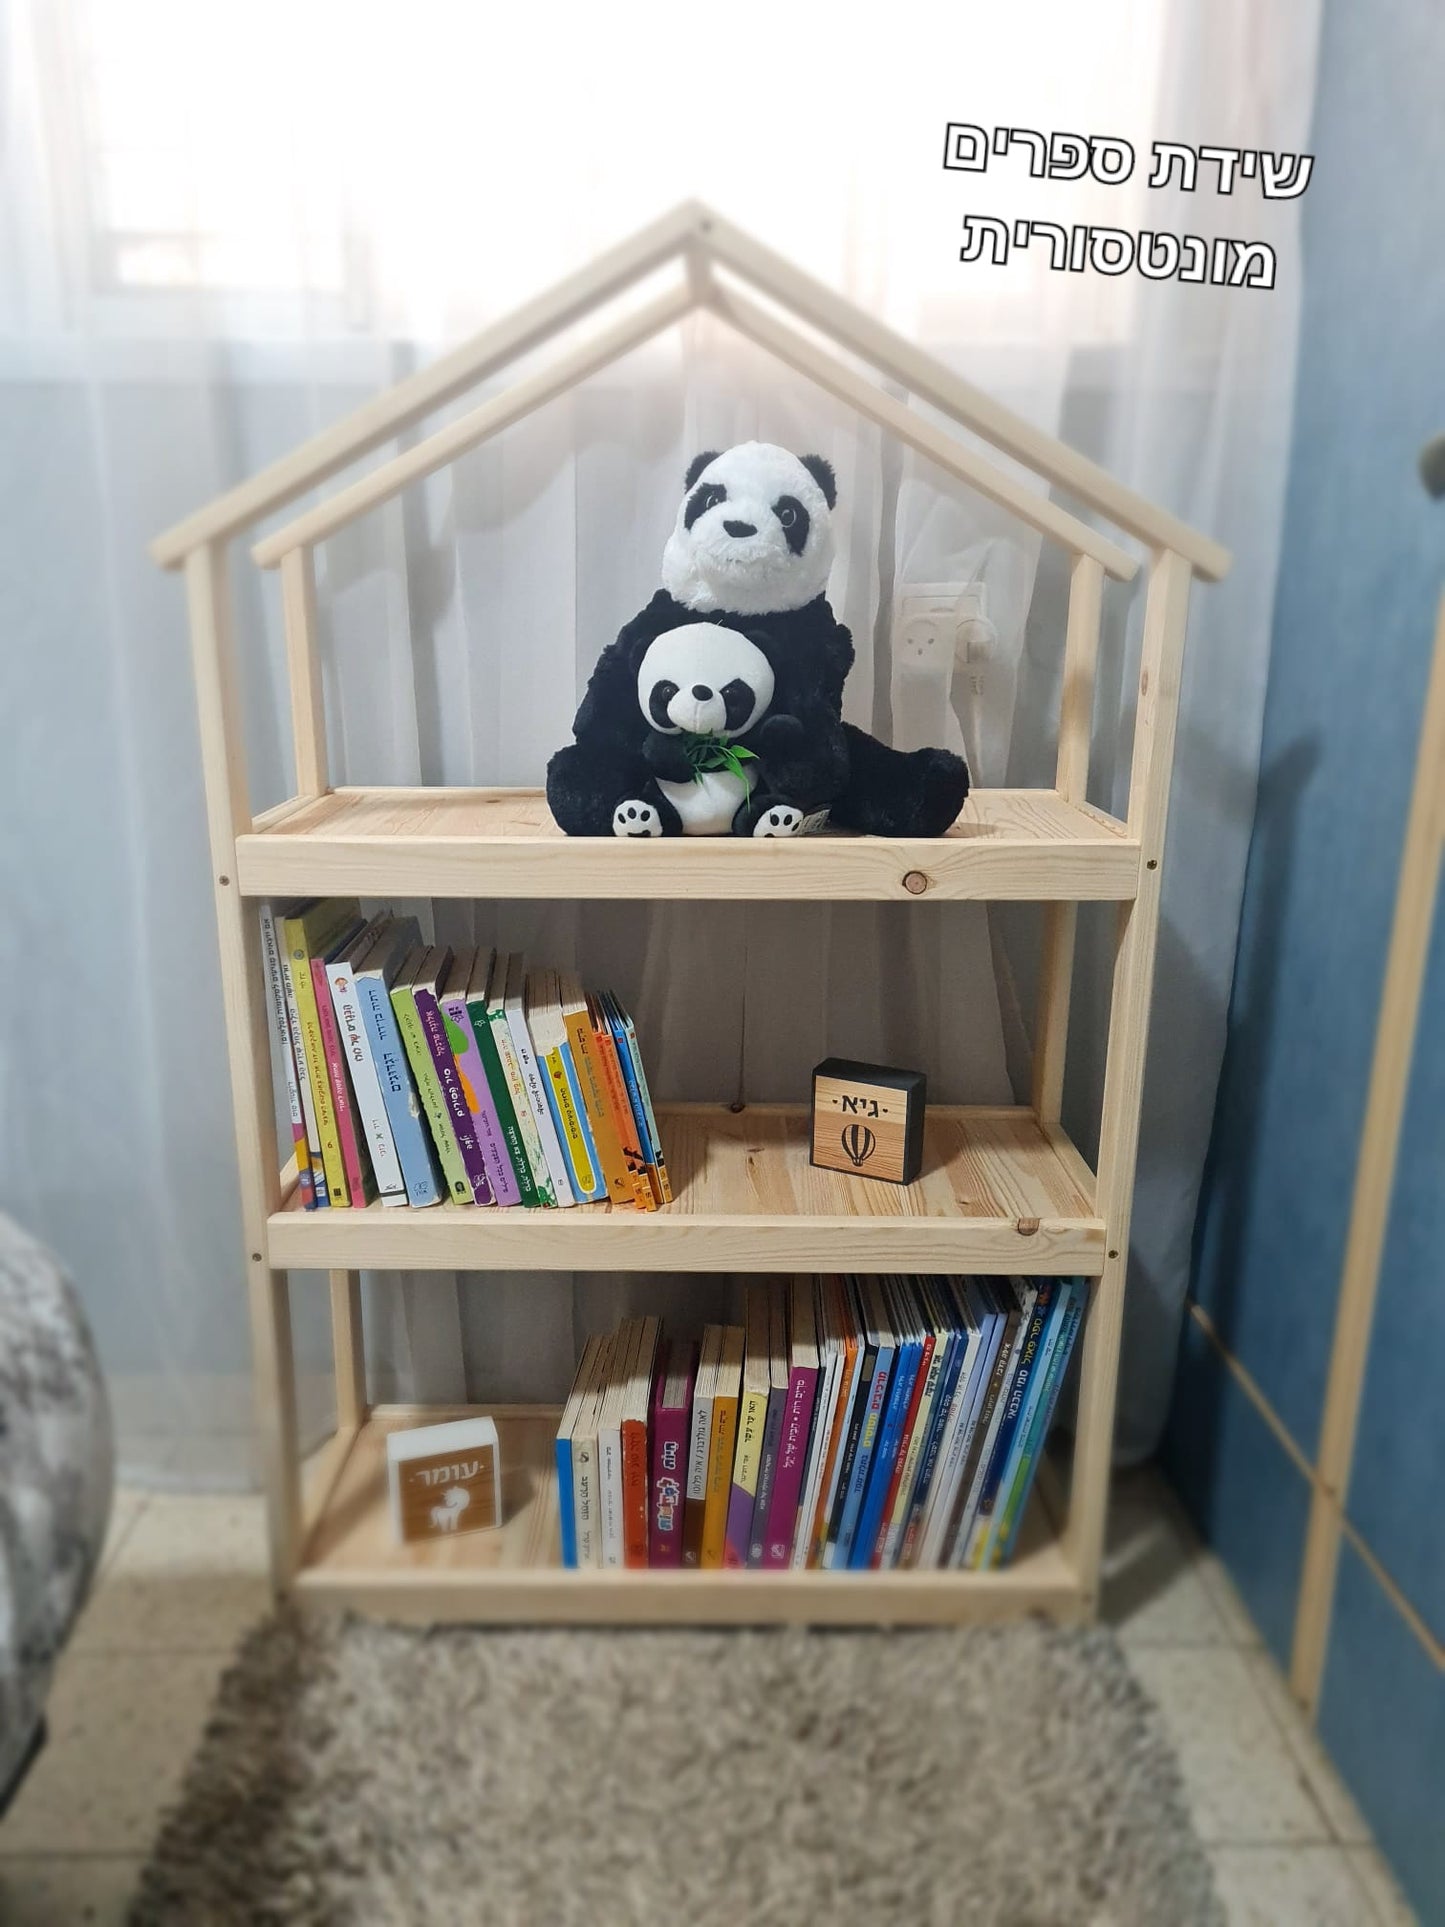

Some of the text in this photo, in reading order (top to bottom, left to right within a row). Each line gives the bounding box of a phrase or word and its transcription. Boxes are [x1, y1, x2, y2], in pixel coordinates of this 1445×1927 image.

[262, 917, 271, 929] אם
[264, 930, 275, 955] יוצאים
[271, 983, 284, 1015] למקומות
[367, 988, 381, 1011] דתיה
[348, 1032, 361, 1046] של
[422, 1009, 445, 1057] אלונה פרנקל
[382, 1051, 403, 1093] דגדוגים
[441, 1066, 465, 1118] סיר הסירים
[842, 1095, 879, 1118] גיא
[1028, 1317, 1043, 1340] ספר
[1000, 1341, 1011, 1359] איפה
[1020, 1338, 1037, 1366] פאזל
[870, 1369, 887, 1411] מרכיבים
[1014, 1368, 1028, 1389] סמי
[696, 1408, 706, 1424] לאה
[747, 1399, 756, 1413] האו
[1005, 1388, 1022, 1420] הכבאי
[782, 1378, 805, 1469] מרים רות הבית של יעל
[862, 1411, 878, 1448] מטוסים
[694, 1426, 706, 1453] גולדברג
[629, 1453, 639, 1468] טוב
[660, 1440, 679, 1469] חיות
[694, 1460, 702, 1473] איה
[416, 1461, 479, 1486] עומר
[691, 1474, 702, 1494] פלוטו
